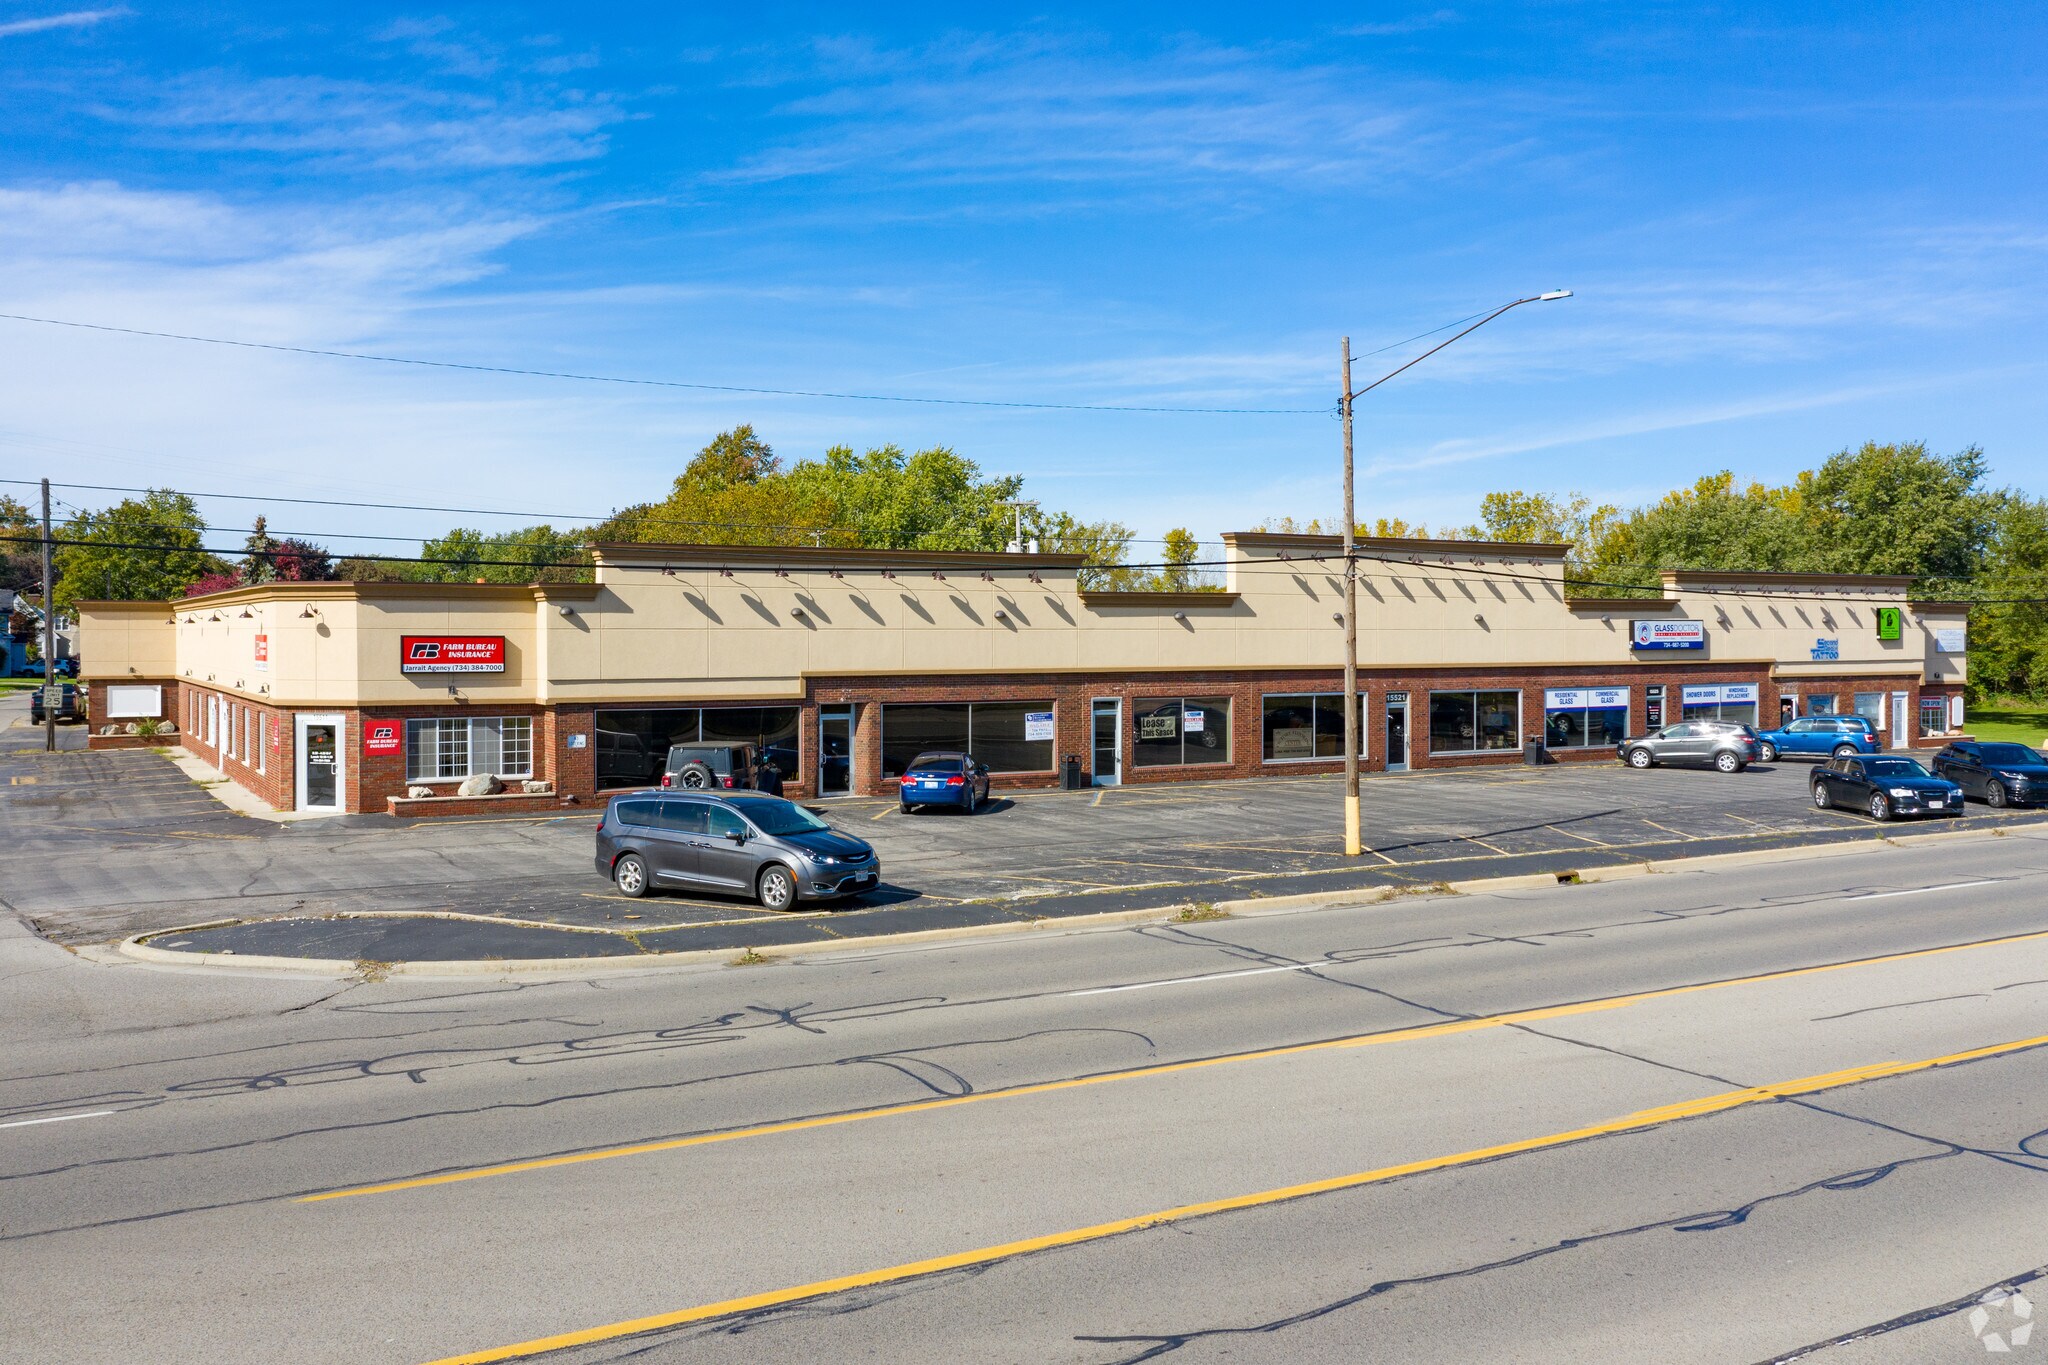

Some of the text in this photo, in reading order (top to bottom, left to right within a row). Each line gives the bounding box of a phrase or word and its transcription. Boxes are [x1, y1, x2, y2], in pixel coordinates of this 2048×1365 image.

[443, 643, 497, 651] FARM BUREAU
[1811, 649, 1839, 660] TATTOO
[427, 665, 451, 673] Agency
[452, 664, 470, 672] (734)
[1686, 690, 1717, 699] SHOWER DOORS
[45, 697, 61, 706] 25
[1142, 718, 1166, 728] Lease
[1155, 729, 1174, 737] Space
